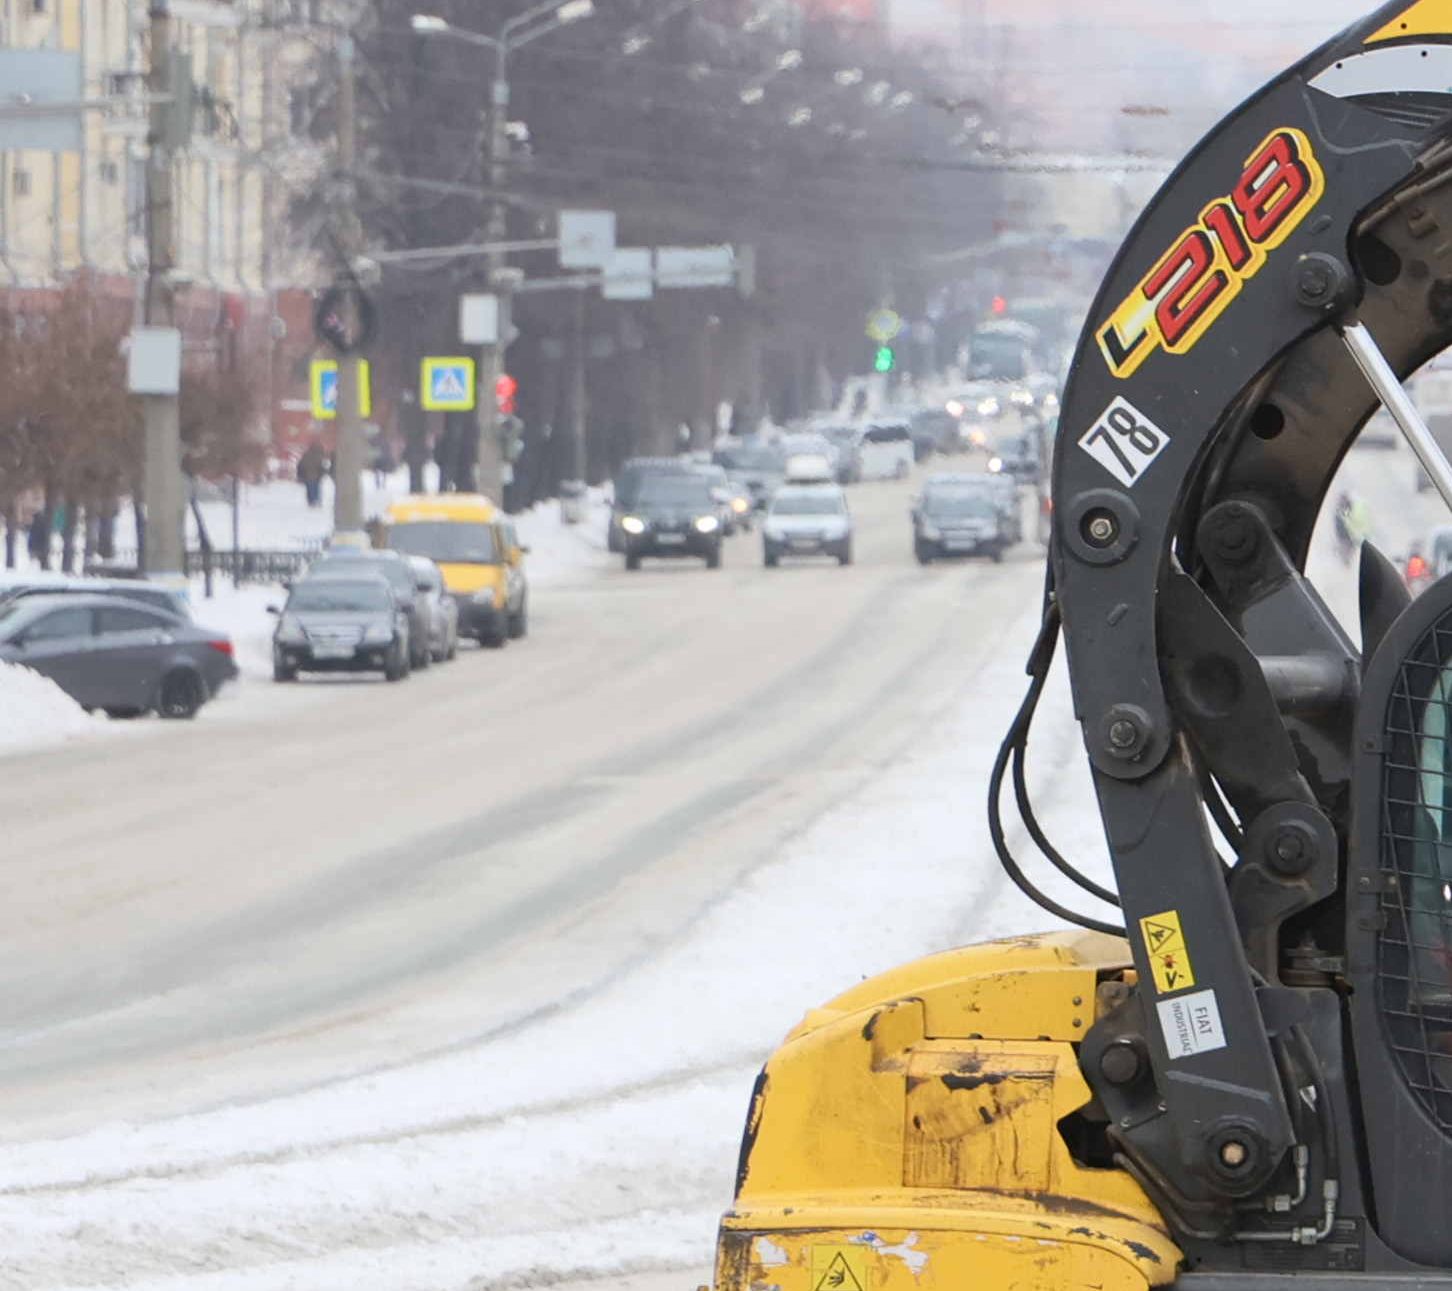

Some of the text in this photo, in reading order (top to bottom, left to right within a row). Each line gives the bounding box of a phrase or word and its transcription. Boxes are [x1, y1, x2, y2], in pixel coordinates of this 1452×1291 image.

[1098, 129, 1317, 376] L218
[1086, 406, 1160, 478] 78
[1194, 1006, 1213, 1035] FIAT
